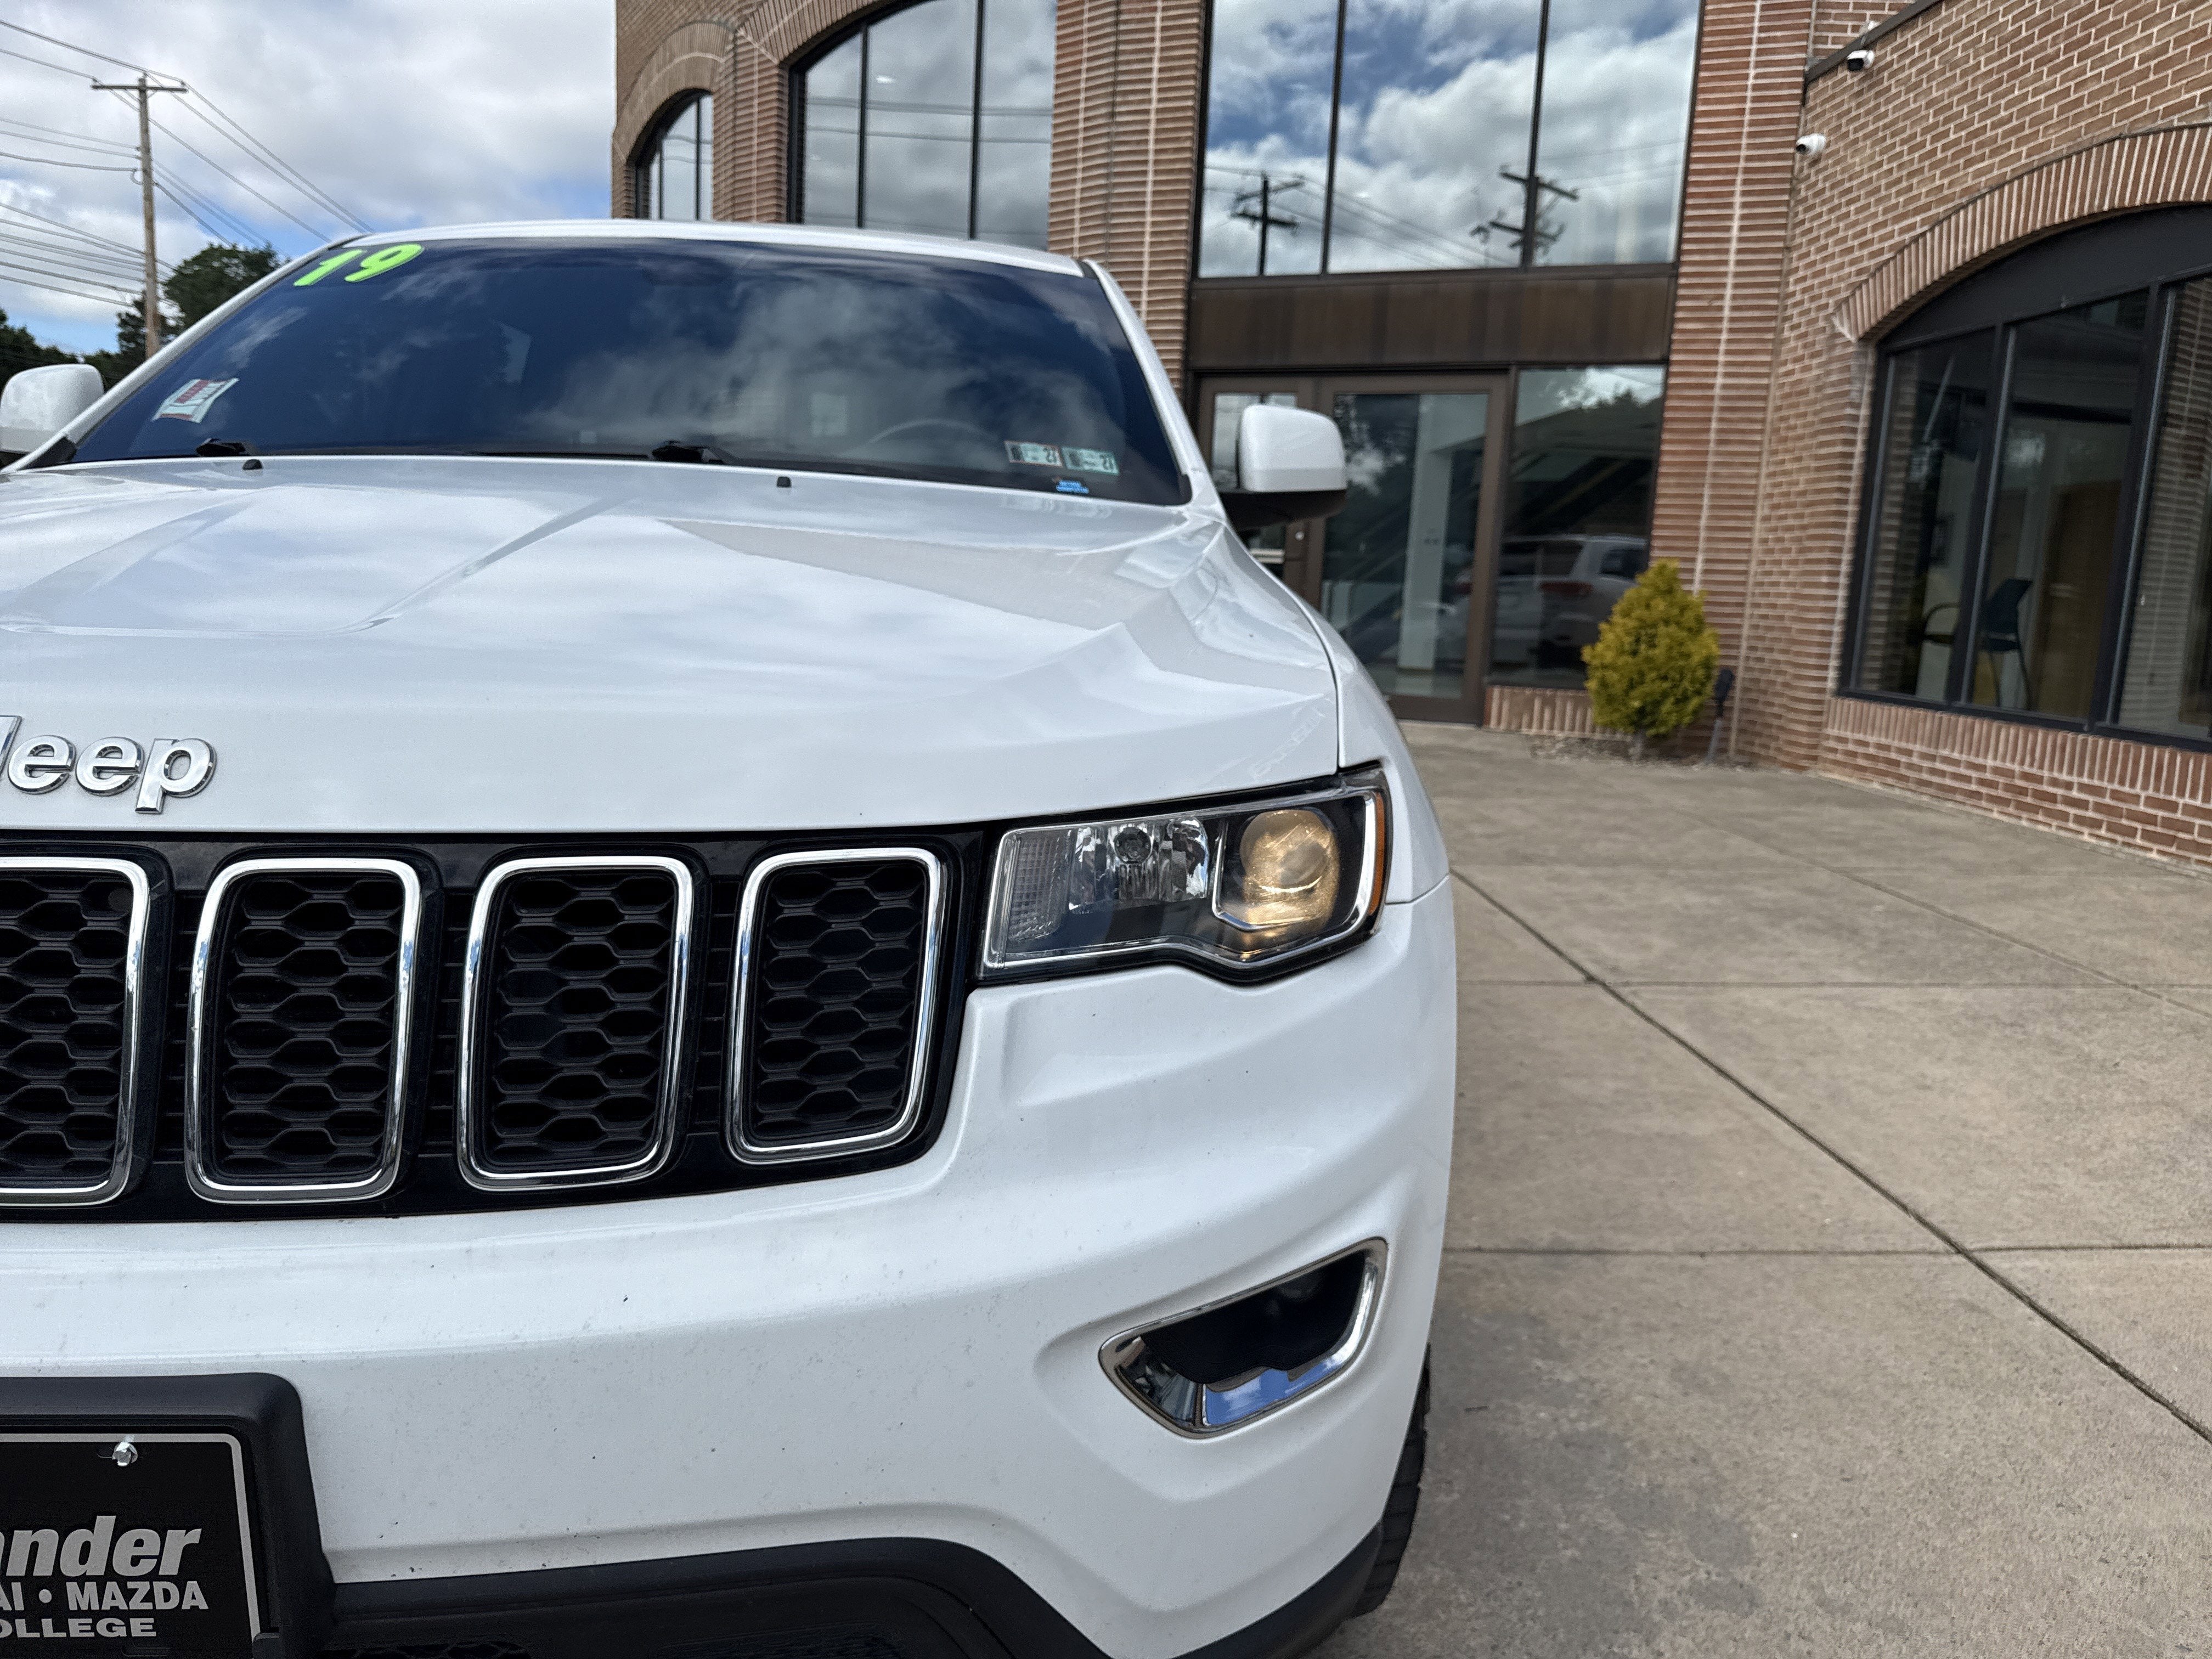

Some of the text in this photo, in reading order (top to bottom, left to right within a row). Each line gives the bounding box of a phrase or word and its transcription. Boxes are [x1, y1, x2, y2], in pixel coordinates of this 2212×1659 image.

[293, 243, 424, 286] 19
[0, 715, 217, 814] eep
[0, 1515, 202, 1577] nder
[65, 1581, 208, 1610] MAZDA
